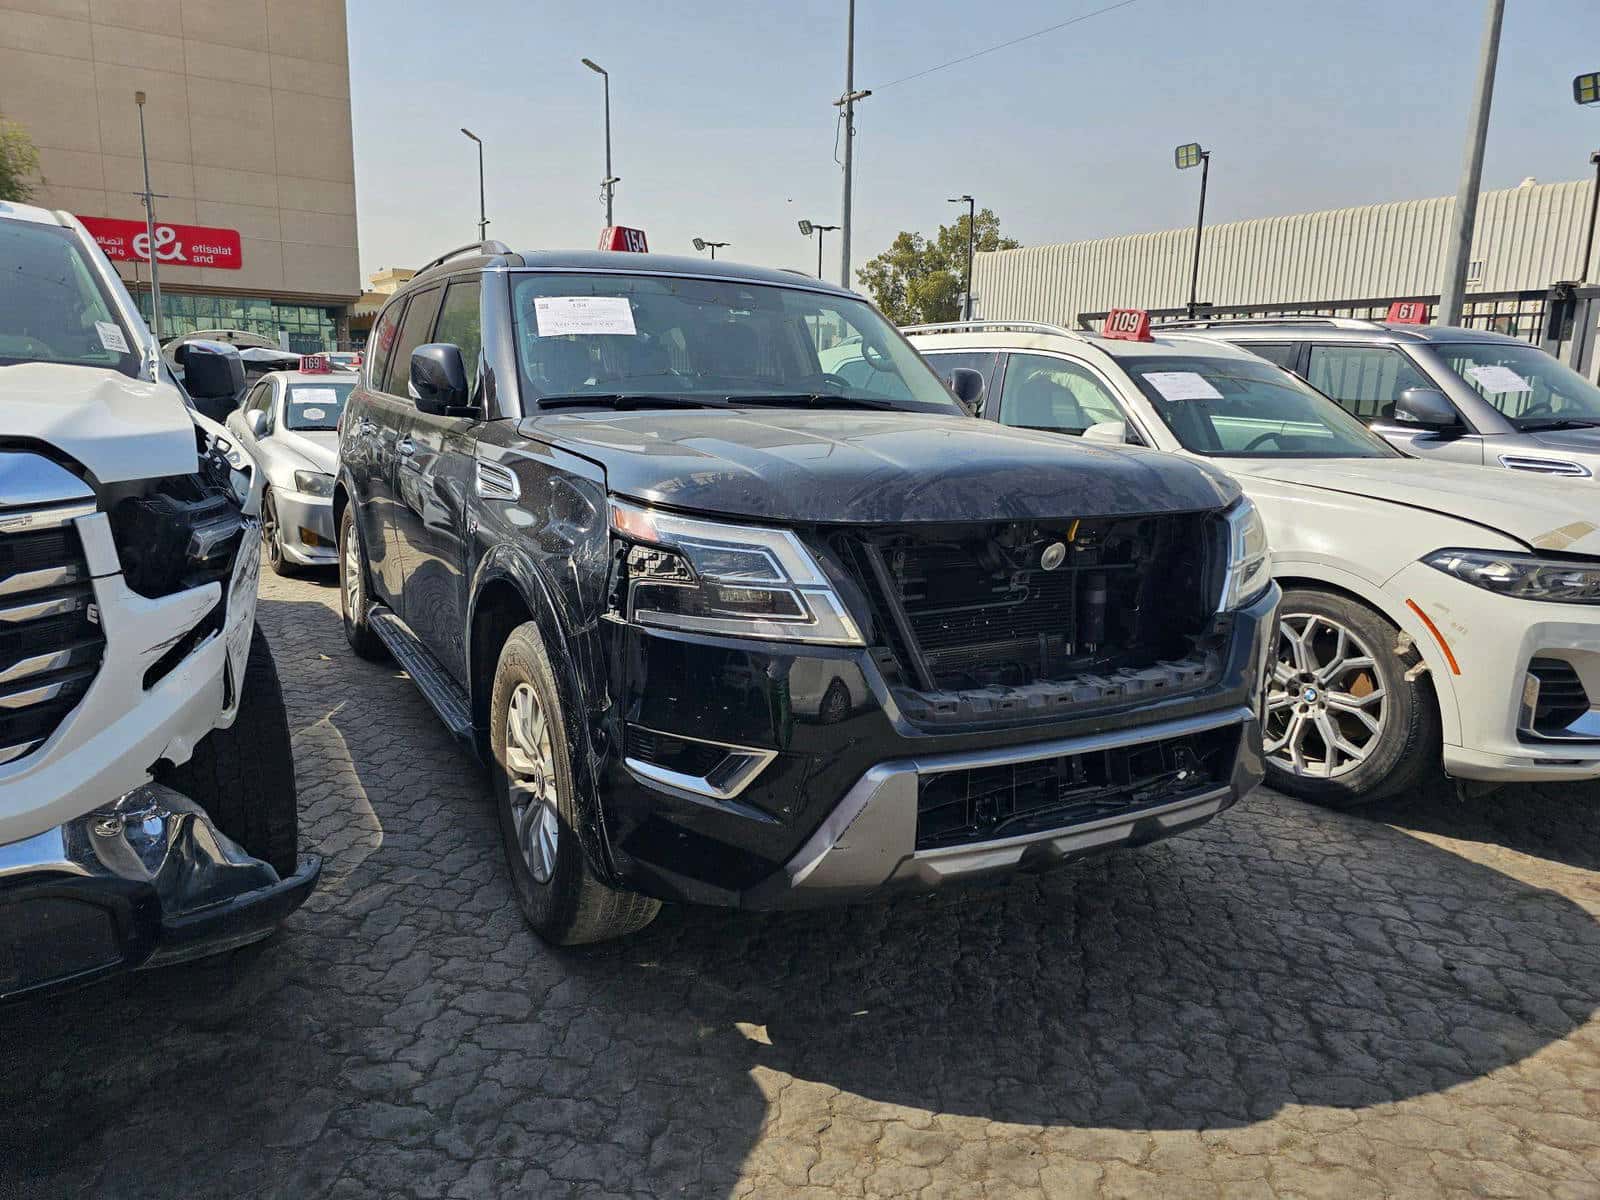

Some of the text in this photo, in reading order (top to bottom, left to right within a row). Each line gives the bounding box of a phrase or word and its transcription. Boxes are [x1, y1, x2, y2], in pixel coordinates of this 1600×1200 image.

[96, 236, 123, 246] اتصالا
[624, 229, 647, 252] 154
[192, 244, 232, 256] etisalat
[193, 255, 214, 264] and
[1399, 303, 1416, 319] 61
[1112, 311, 1139, 332] 109
[304, 357, 320, 369] 169
